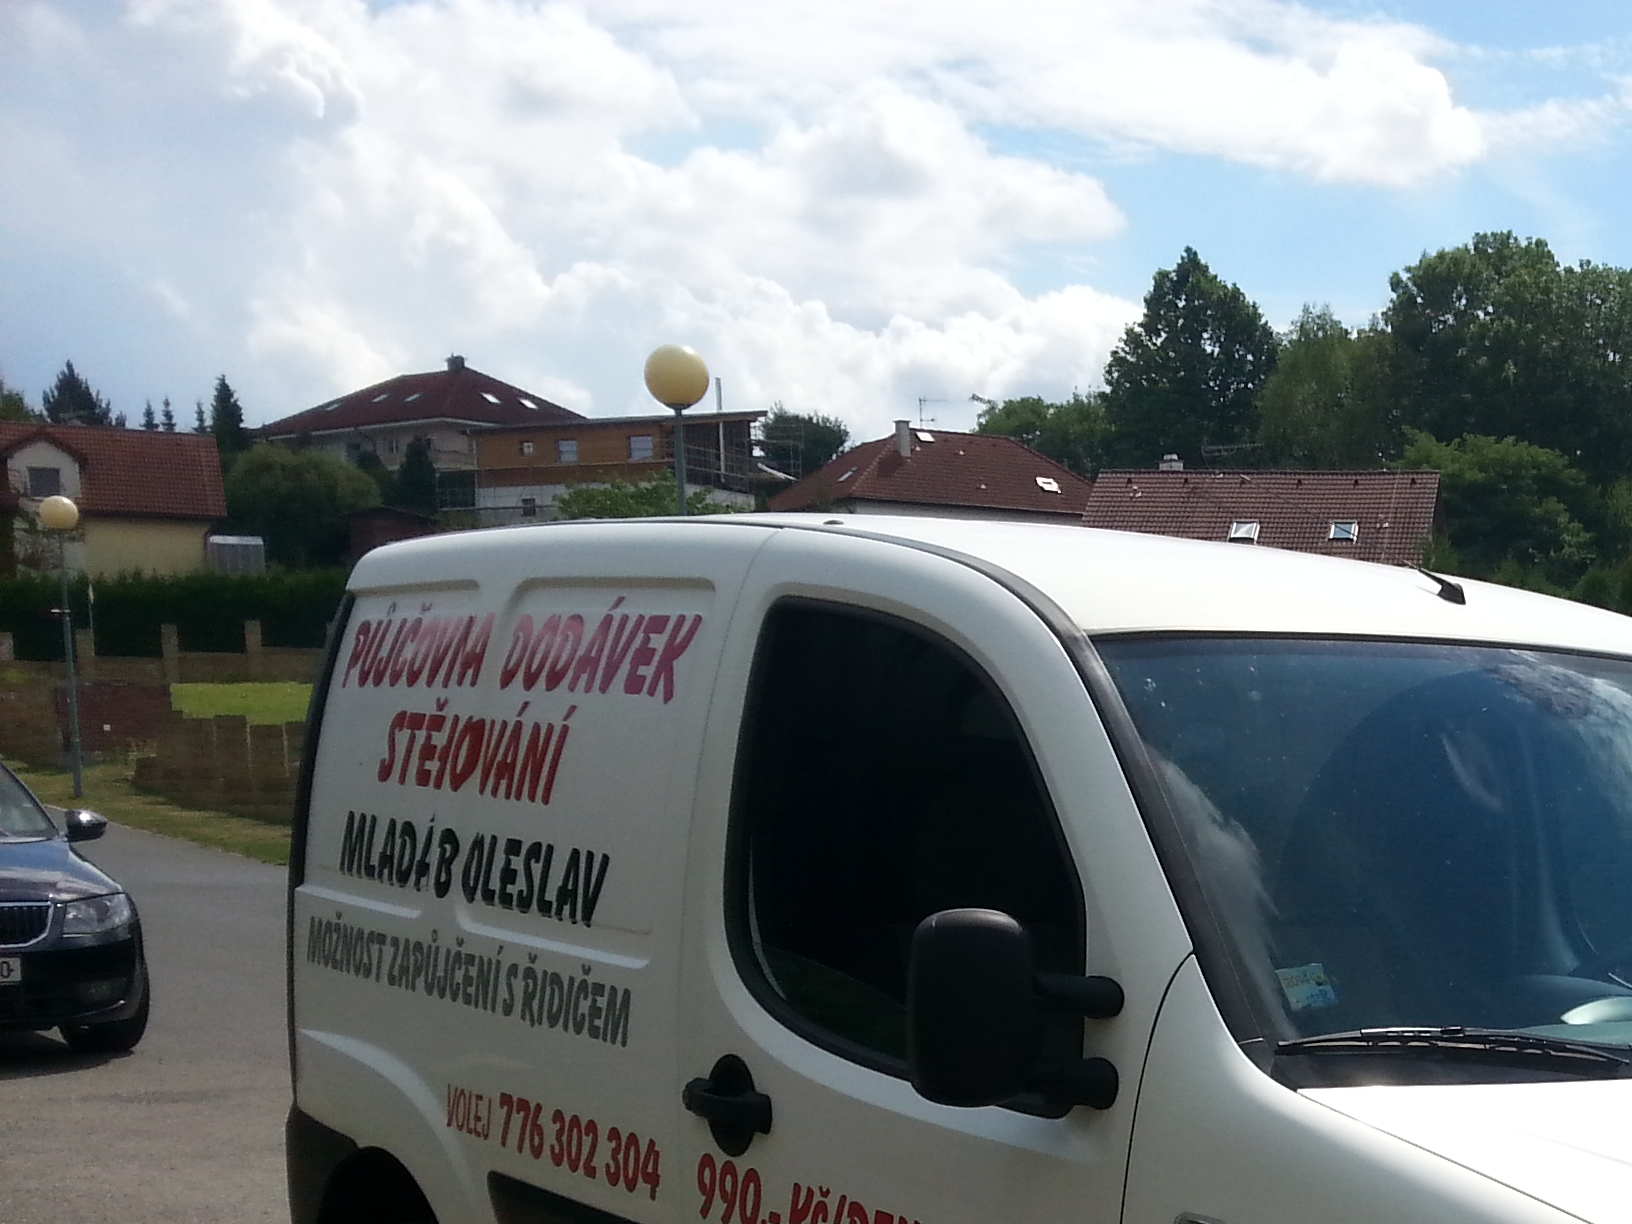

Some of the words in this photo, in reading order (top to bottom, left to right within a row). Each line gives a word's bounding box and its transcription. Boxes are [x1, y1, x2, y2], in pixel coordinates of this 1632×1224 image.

[500, 596, 703, 704] DODÁVEK
[305, 911, 387, 982] MOŽNOST
[387, 929, 504, 1014] ZAPŮJČENÍ
[502, 962, 519, 1017] S
[520, 952, 632, 1048] ŘIDIČEM
[446, 1084, 492, 1140] VOLEJ
[500, 1092, 545, 1160] 776
[550, 1108, 600, 1180] 302
[605, 1126, 661, 1200] 304
